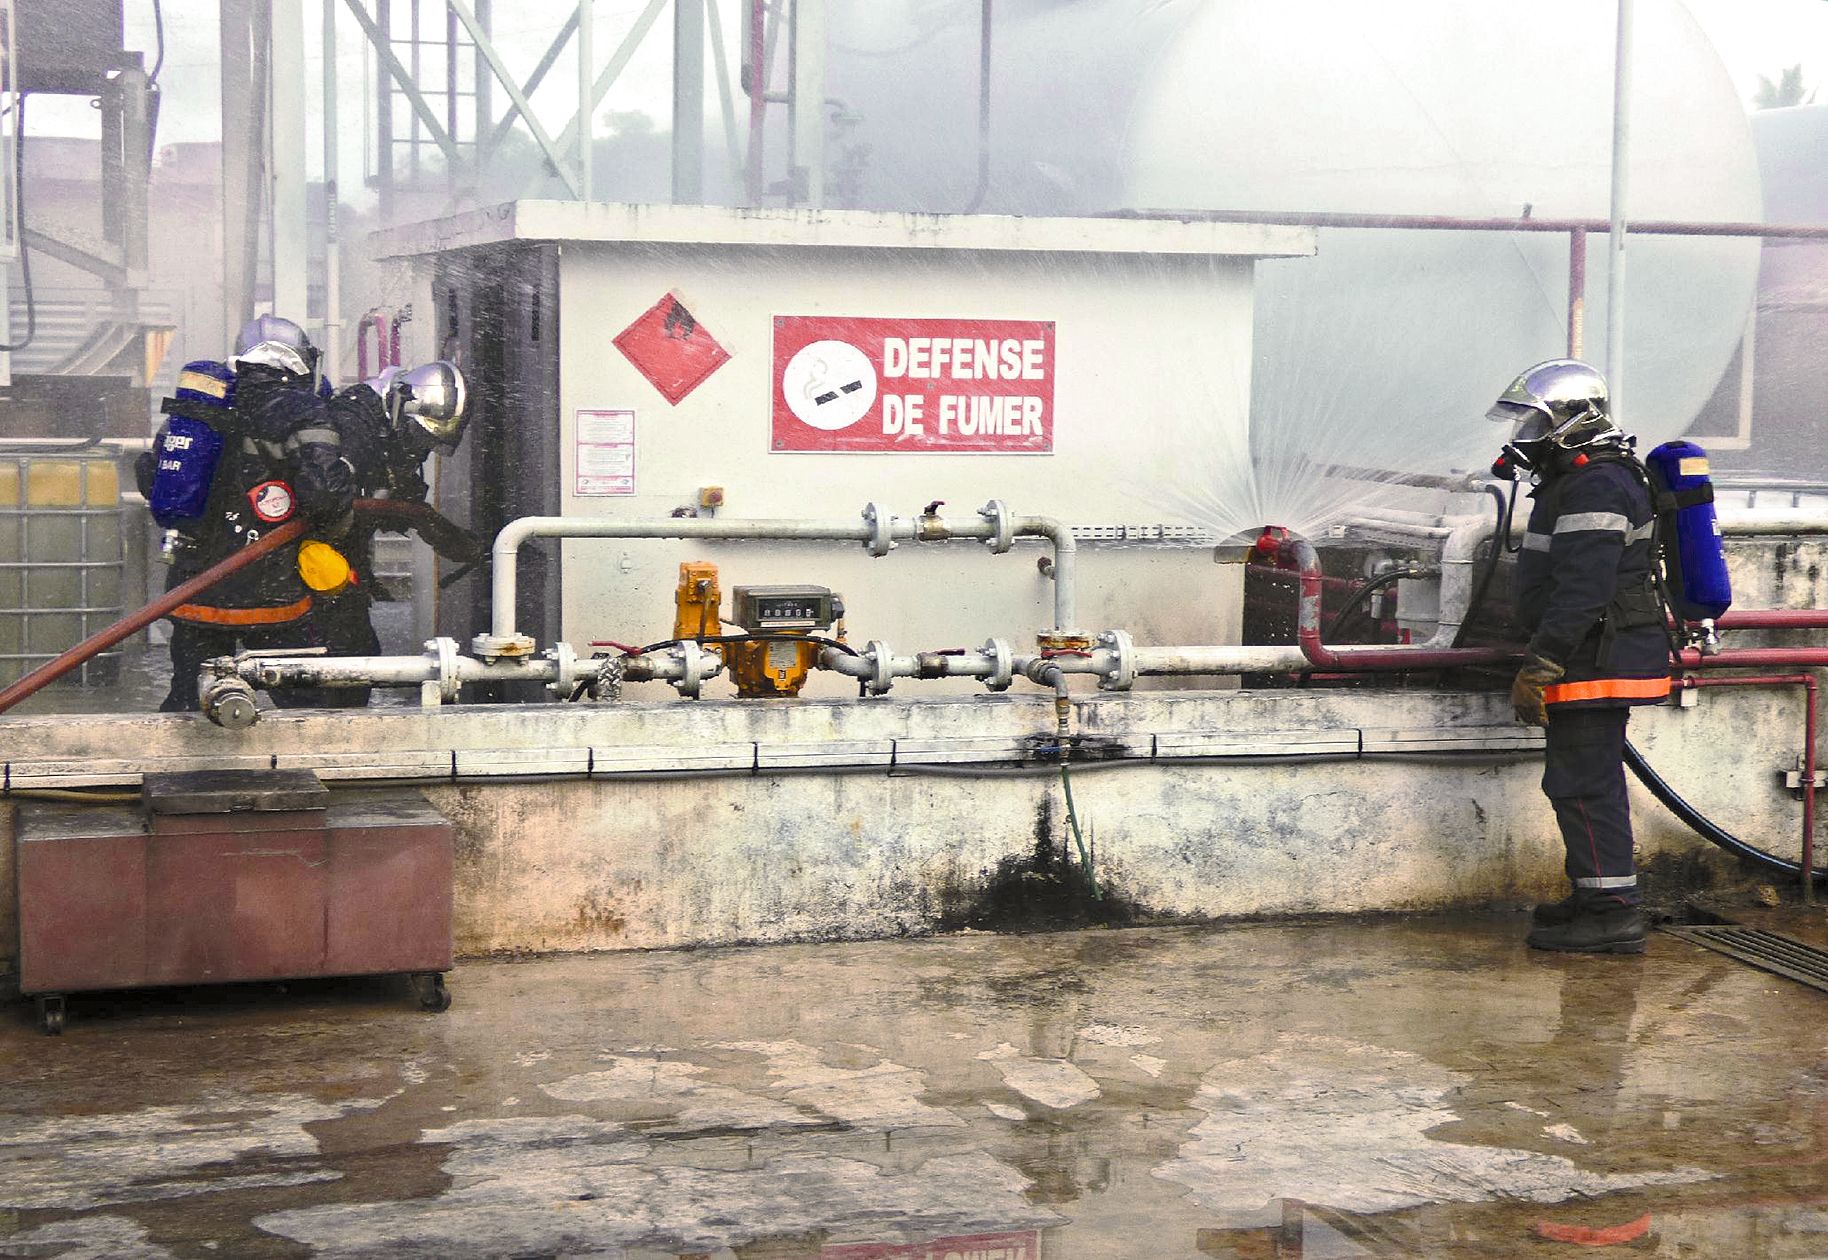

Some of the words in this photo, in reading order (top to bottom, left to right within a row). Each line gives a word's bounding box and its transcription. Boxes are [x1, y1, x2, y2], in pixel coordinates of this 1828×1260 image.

[883, 337, 1045, 380] DEFENSE
[882, 394, 925, 435] DE
[939, 395, 1043, 436] FUMER
